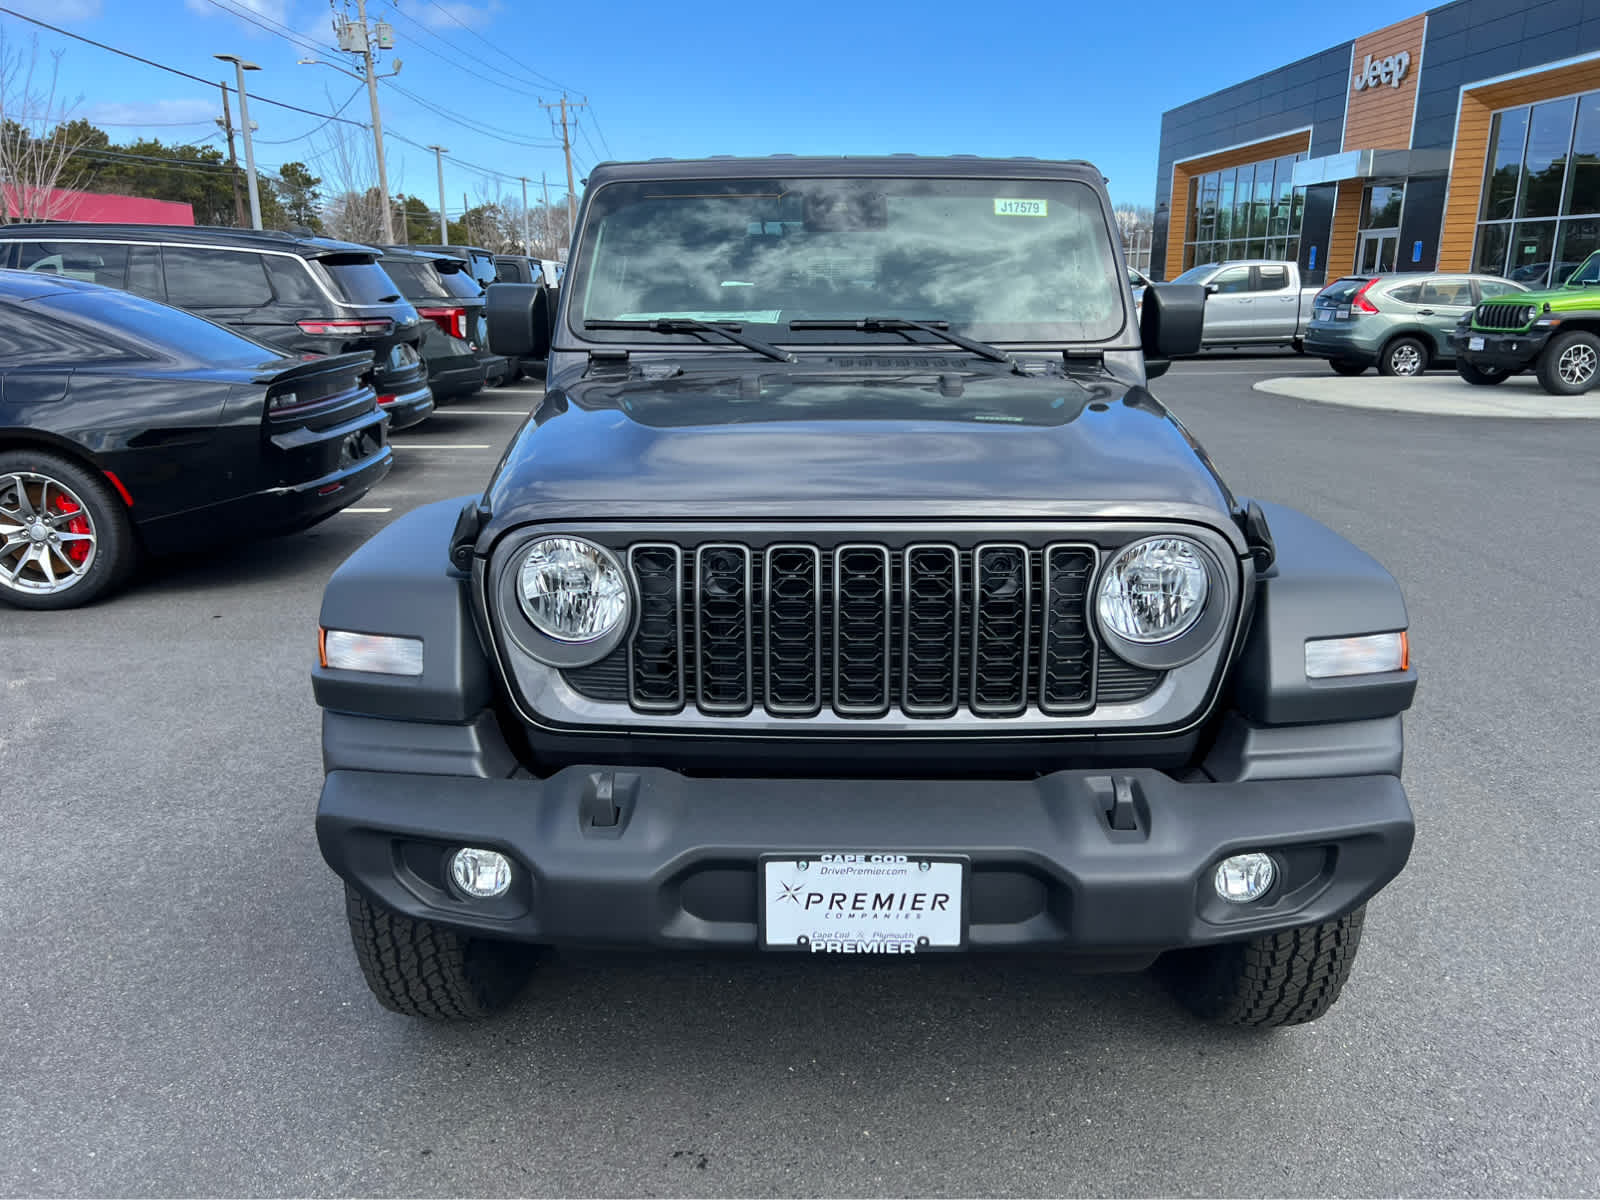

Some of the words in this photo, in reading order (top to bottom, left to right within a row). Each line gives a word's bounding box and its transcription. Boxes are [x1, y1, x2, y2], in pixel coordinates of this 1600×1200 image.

[1354, 50, 1410, 91] Jeep
[1000, 201, 1040, 213] J17579
[821, 854, 866, 863] CAPE
[870, 855, 908, 864] COD
[820, 866, 908, 876] DrivePremier.com
[804, 892, 951, 911] PREMIER
[824, 912, 922, 920] COMPANIES
[872, 931, 915, 940] Plymouth
[810, 940, 917, 954] PREMIER
